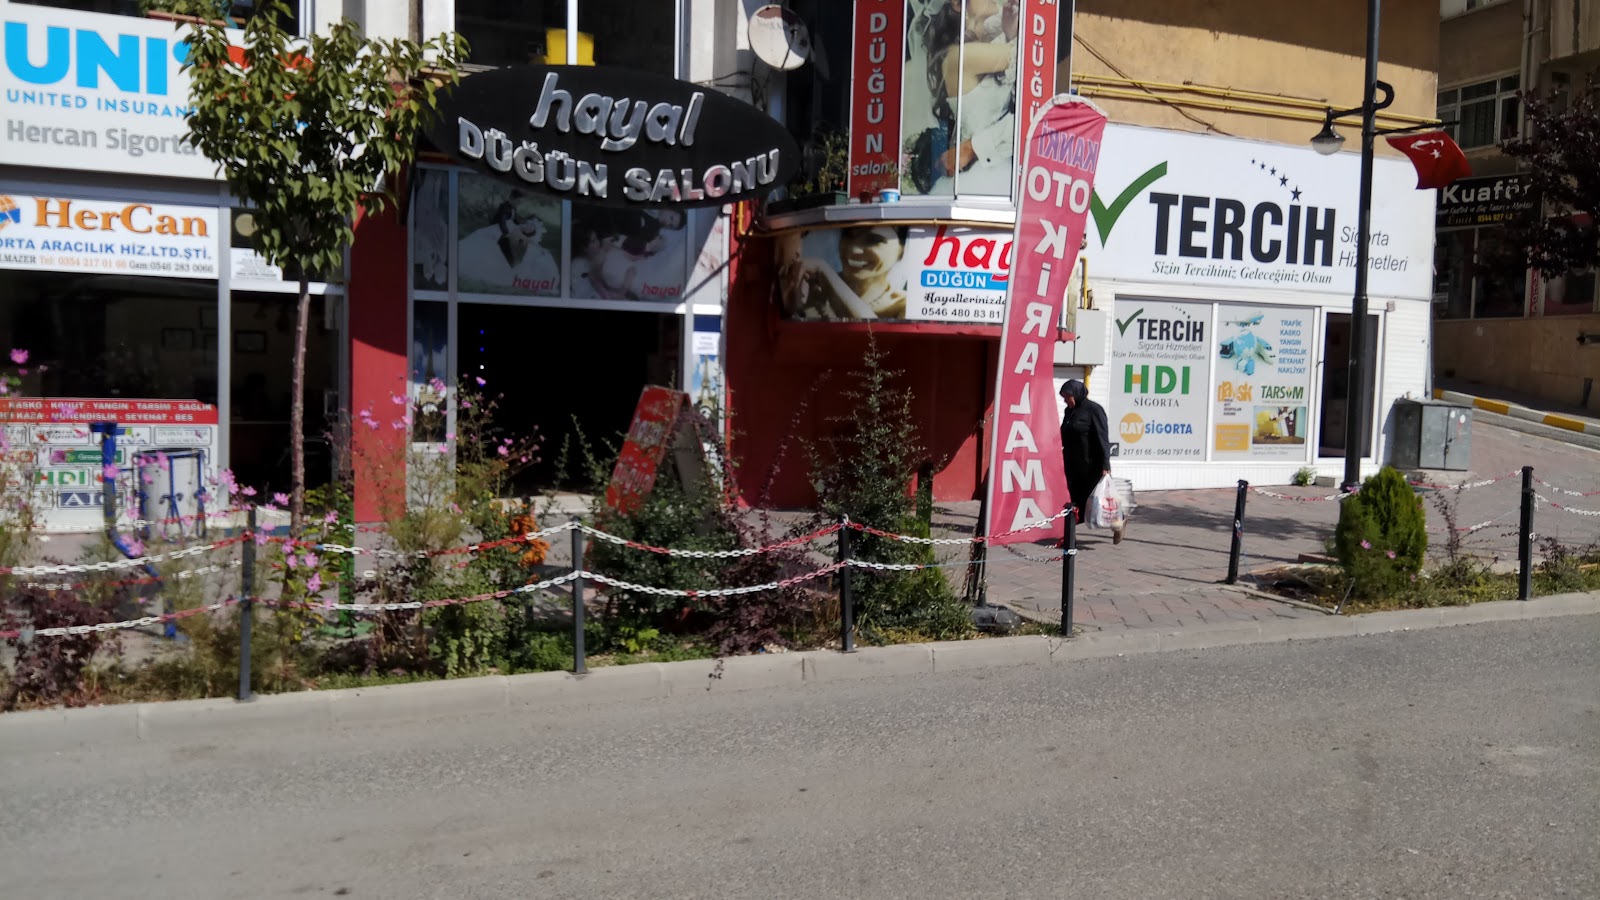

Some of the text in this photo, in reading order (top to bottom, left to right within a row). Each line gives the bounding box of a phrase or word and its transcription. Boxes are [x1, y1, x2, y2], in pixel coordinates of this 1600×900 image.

[1029, 13, 1046, 123] DÜĞÜ
[866, 12, 888, 154] DÜĞÜN
[7, 89, 200, 119] UNITED INSURAN
[530, 72, 705, 152] hayal
[7, 119, 97, 148] Hercan
[458, 116, 780, 202] DÜĞÜN SALONU
[32, 197, 209, 238] HerCan
[1149, 187, 1336, 267] TERCİH
[41, 240, 115, 254] ARACILIK
[926, 271, 987, 288] DÜĞÜN
[1152, 260, 1332, 285] Sizin Tercihiniz Geleceğiniz Olsun
[921, 307, 1001, 319] 0546 480 83 81
[1137, 316, 1204, 342] TERCİH
[1124, 364, 1190, 395] HDI
[1134, 396, 1179, 408] SİGORTA
[1120, 420, 1193, 435] RAY SİGORTA
